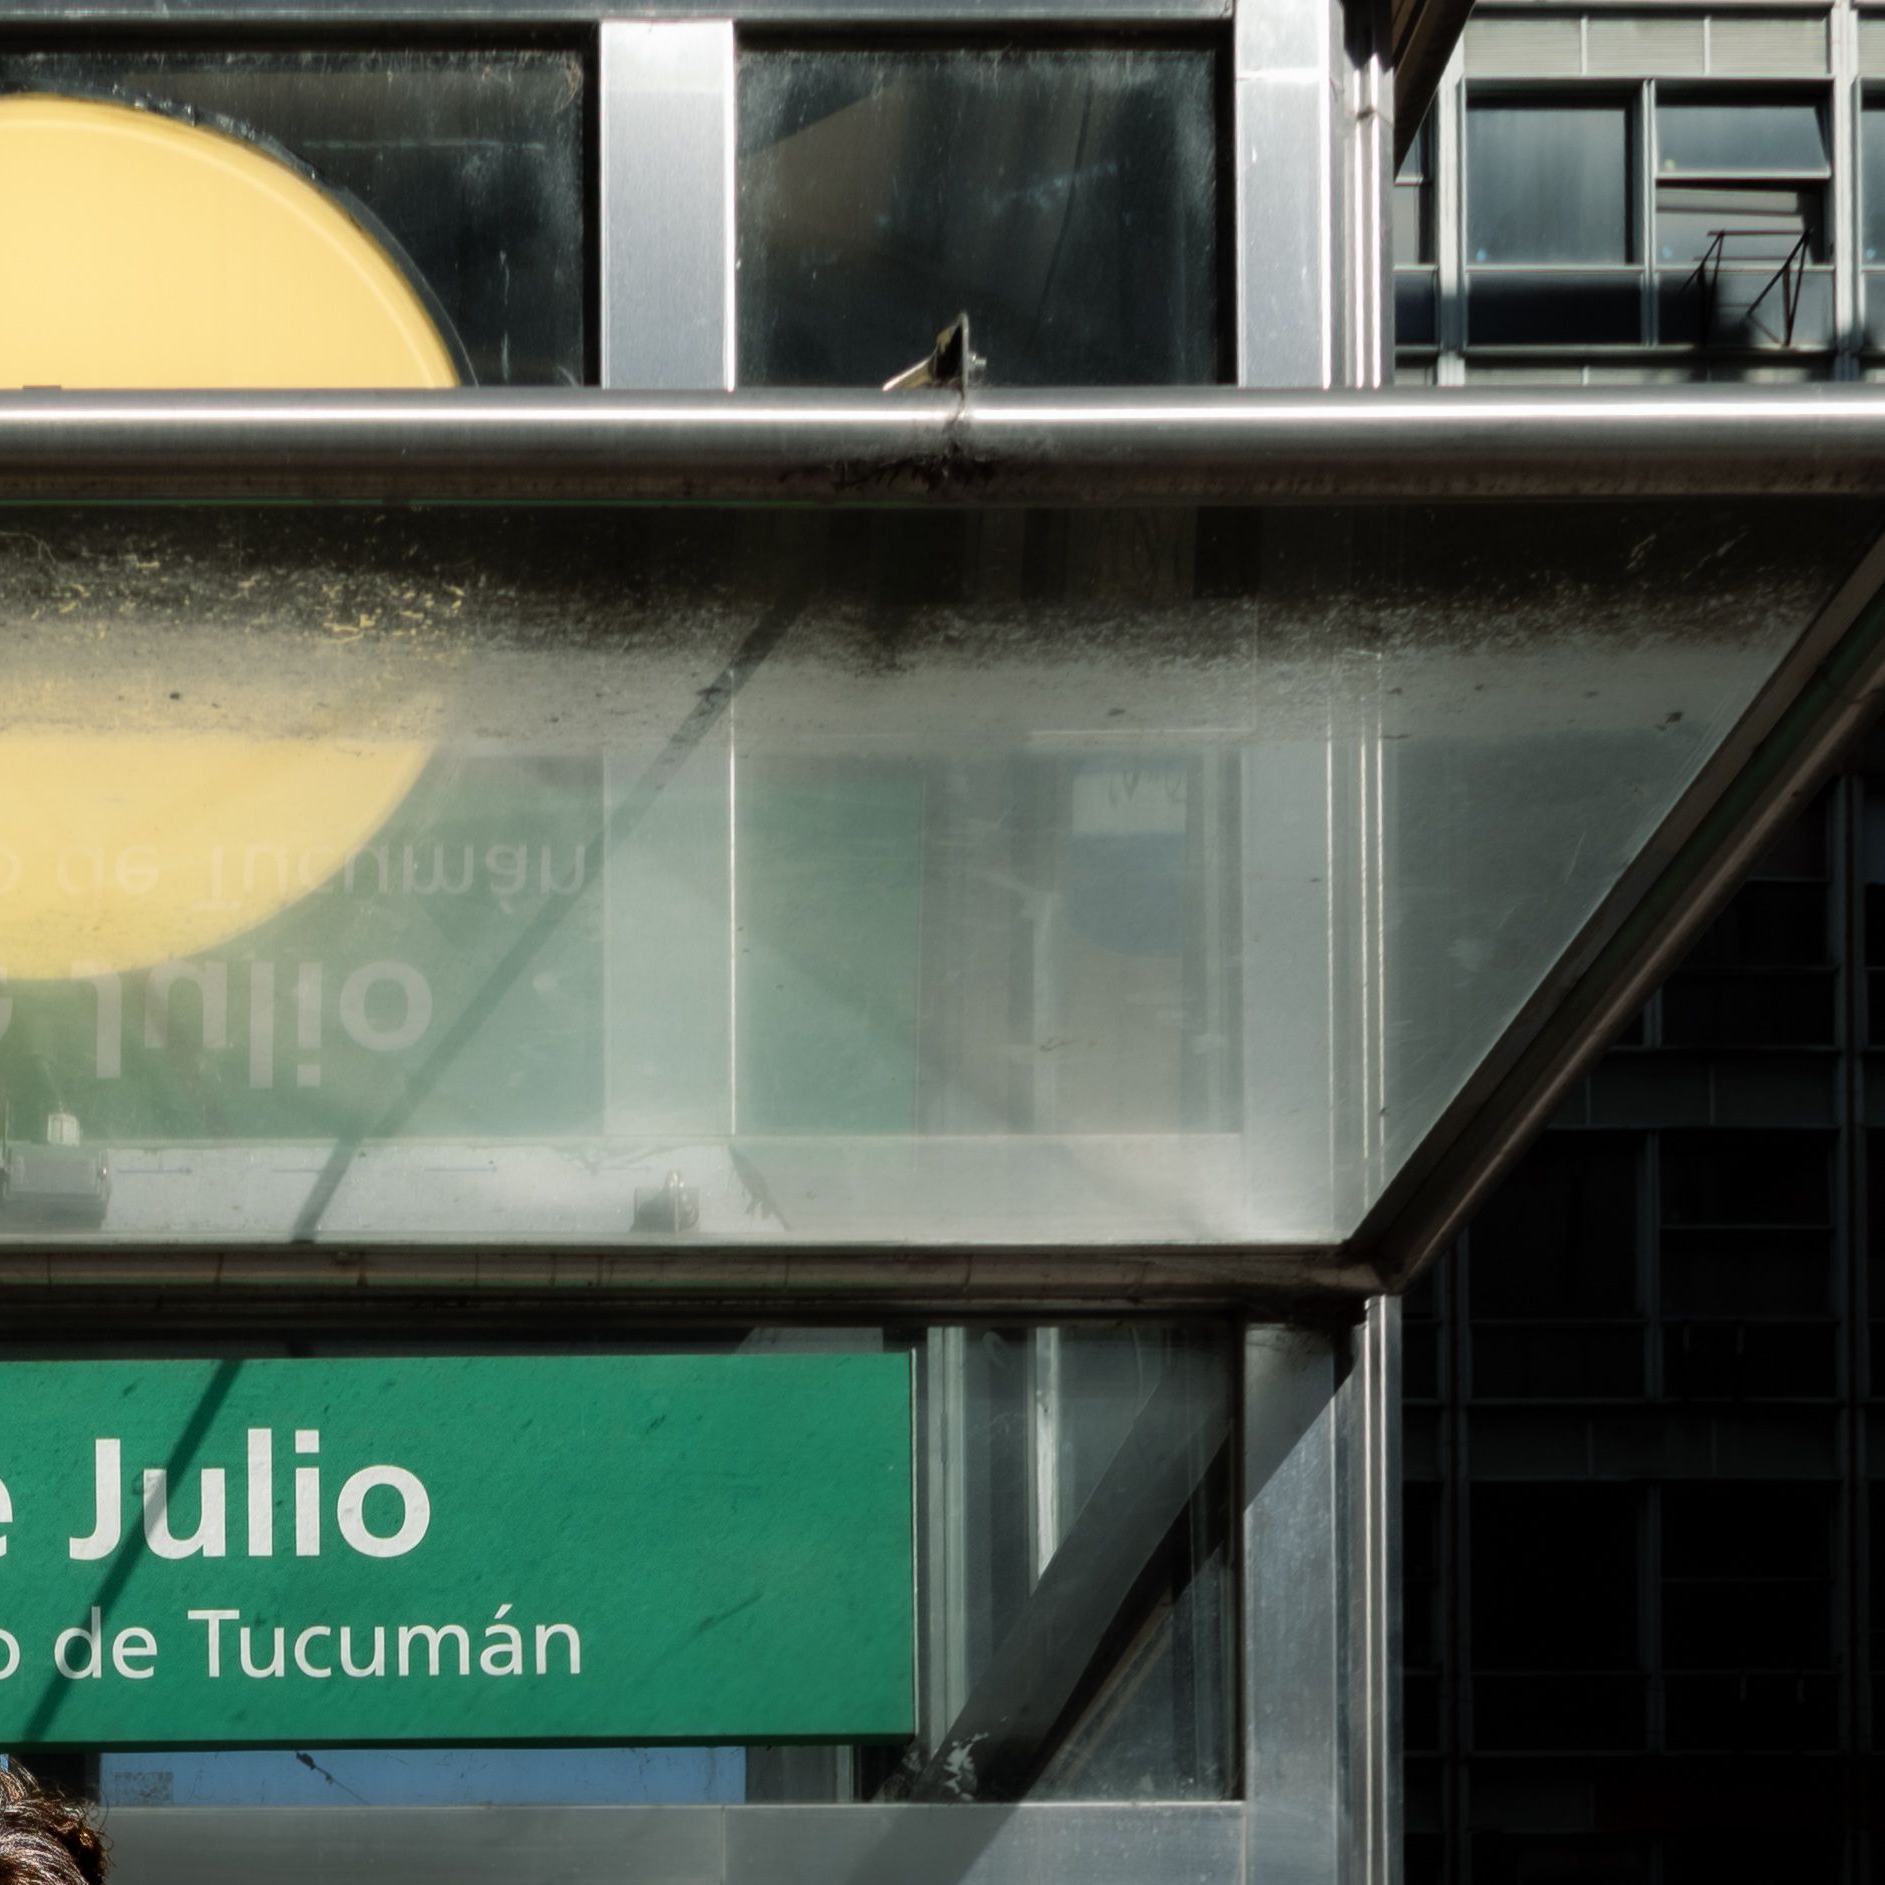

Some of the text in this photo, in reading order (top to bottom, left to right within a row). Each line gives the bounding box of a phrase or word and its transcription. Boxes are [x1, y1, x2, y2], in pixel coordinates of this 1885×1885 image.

[68, 1427, 432, 1561] Julio
[53, 1606, 158, 1681] de
[187, 1604, 583, 1680] Tucumán
